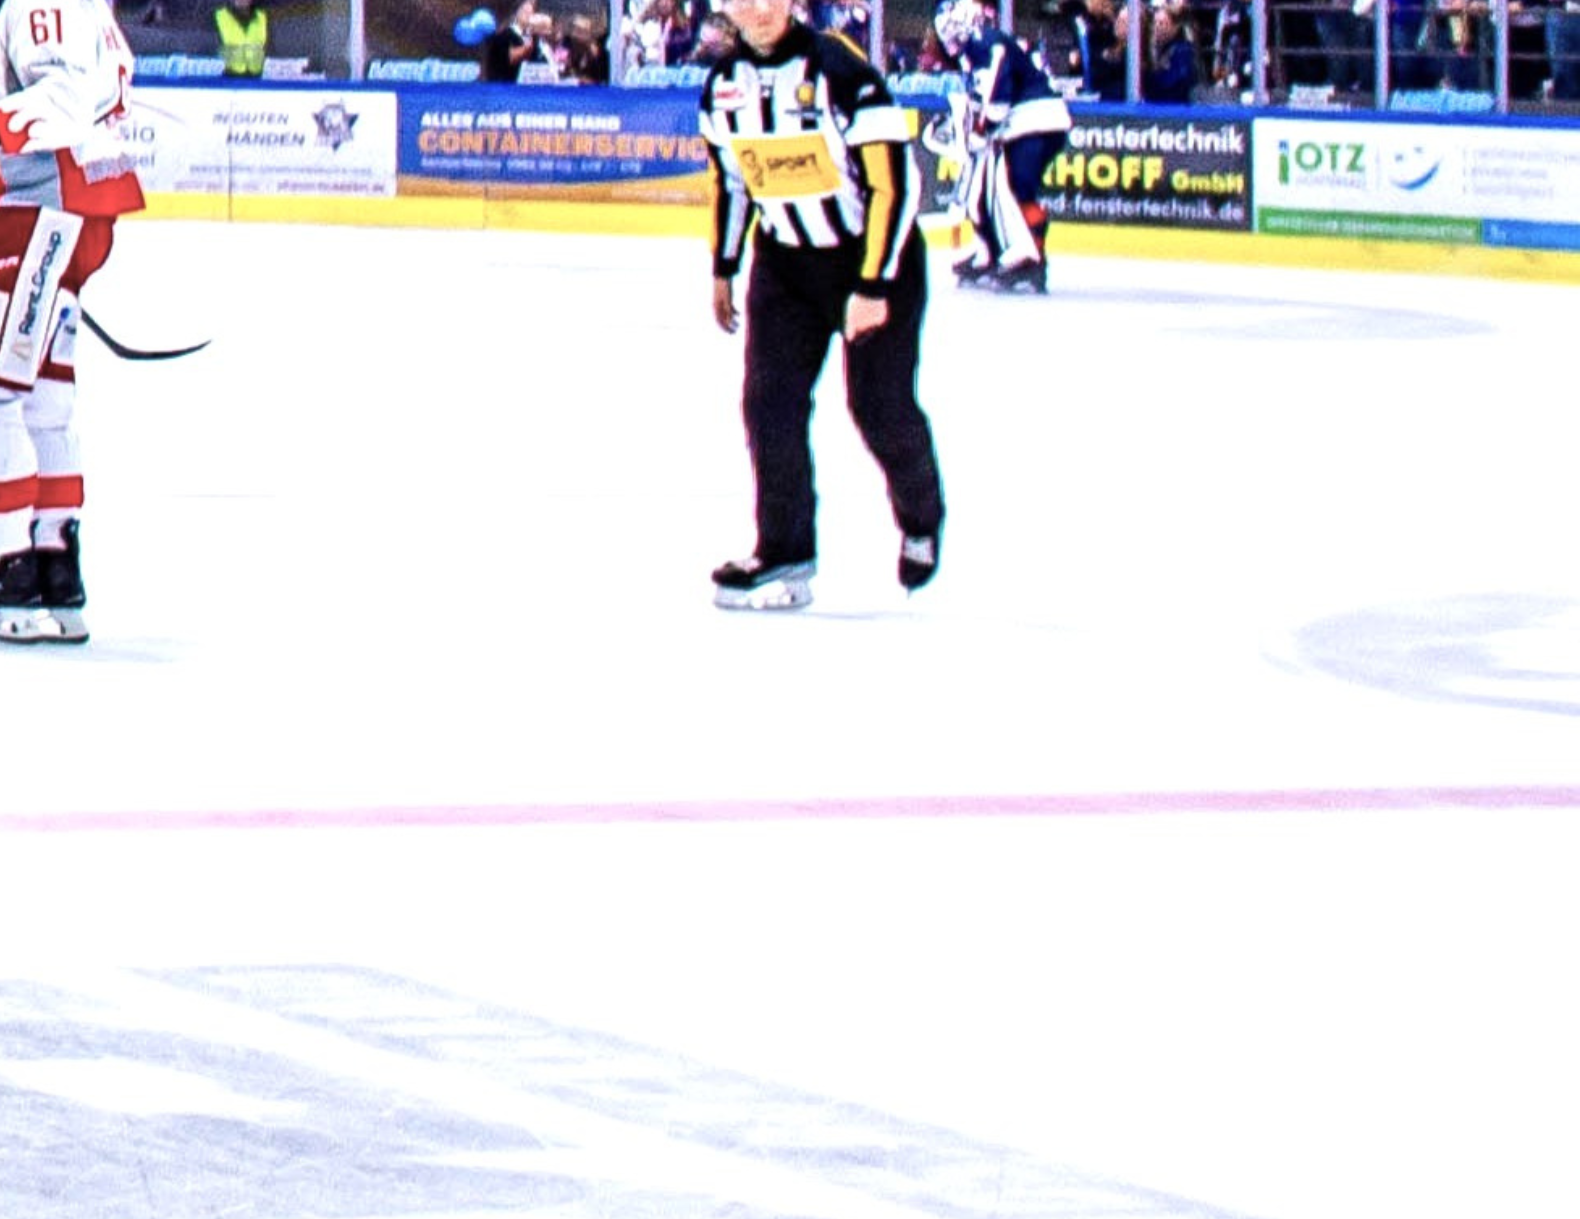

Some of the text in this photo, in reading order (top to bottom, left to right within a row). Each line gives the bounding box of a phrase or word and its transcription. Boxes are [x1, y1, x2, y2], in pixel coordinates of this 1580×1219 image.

[29, 8, 63, 45] 61
[225, 128, 305, 147] HÄNDEN
[418, 129, 709, 161] CONTAINERSERVIC
[1069, 123, 1245, 154] enstertechnik
[1170, 169, 1245, 194] GmbH
